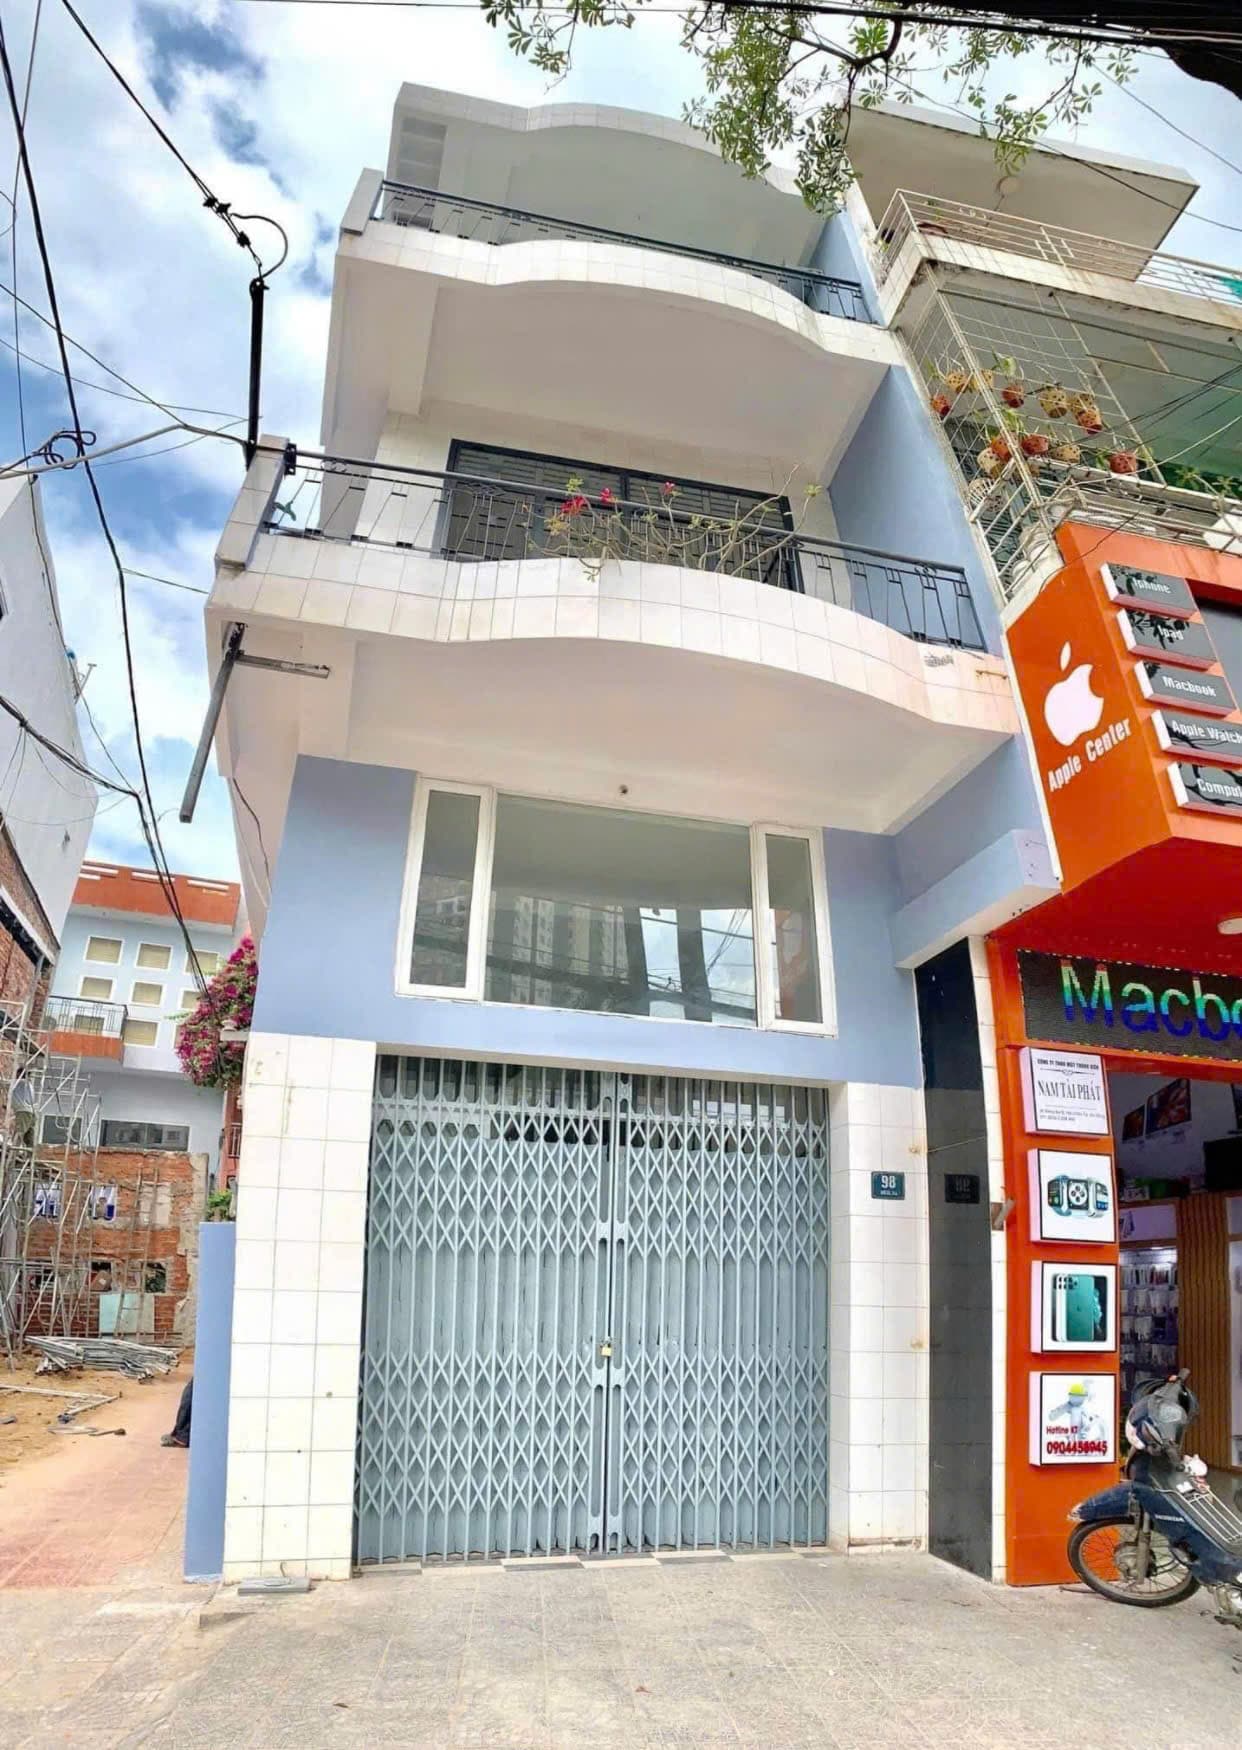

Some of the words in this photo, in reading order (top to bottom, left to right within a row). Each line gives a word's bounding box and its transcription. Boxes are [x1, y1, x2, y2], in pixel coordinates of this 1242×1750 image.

[1162, 676, 1217, 697] Macbook
[1172, 719, 1206, 738] Apple
[1048, 754, 1082, 792] Apple
[1085, 718, 1132, 762] Center
[1038, 1080, 1059, 1097] NAM
[1060, 1078, 1076, 1099] TÀI
[1077, 1080, 1101, 1101] PHÁT
[881, 1175, 896, 1189] 98
[1046, 1426, 1069, 1435] Hotline
